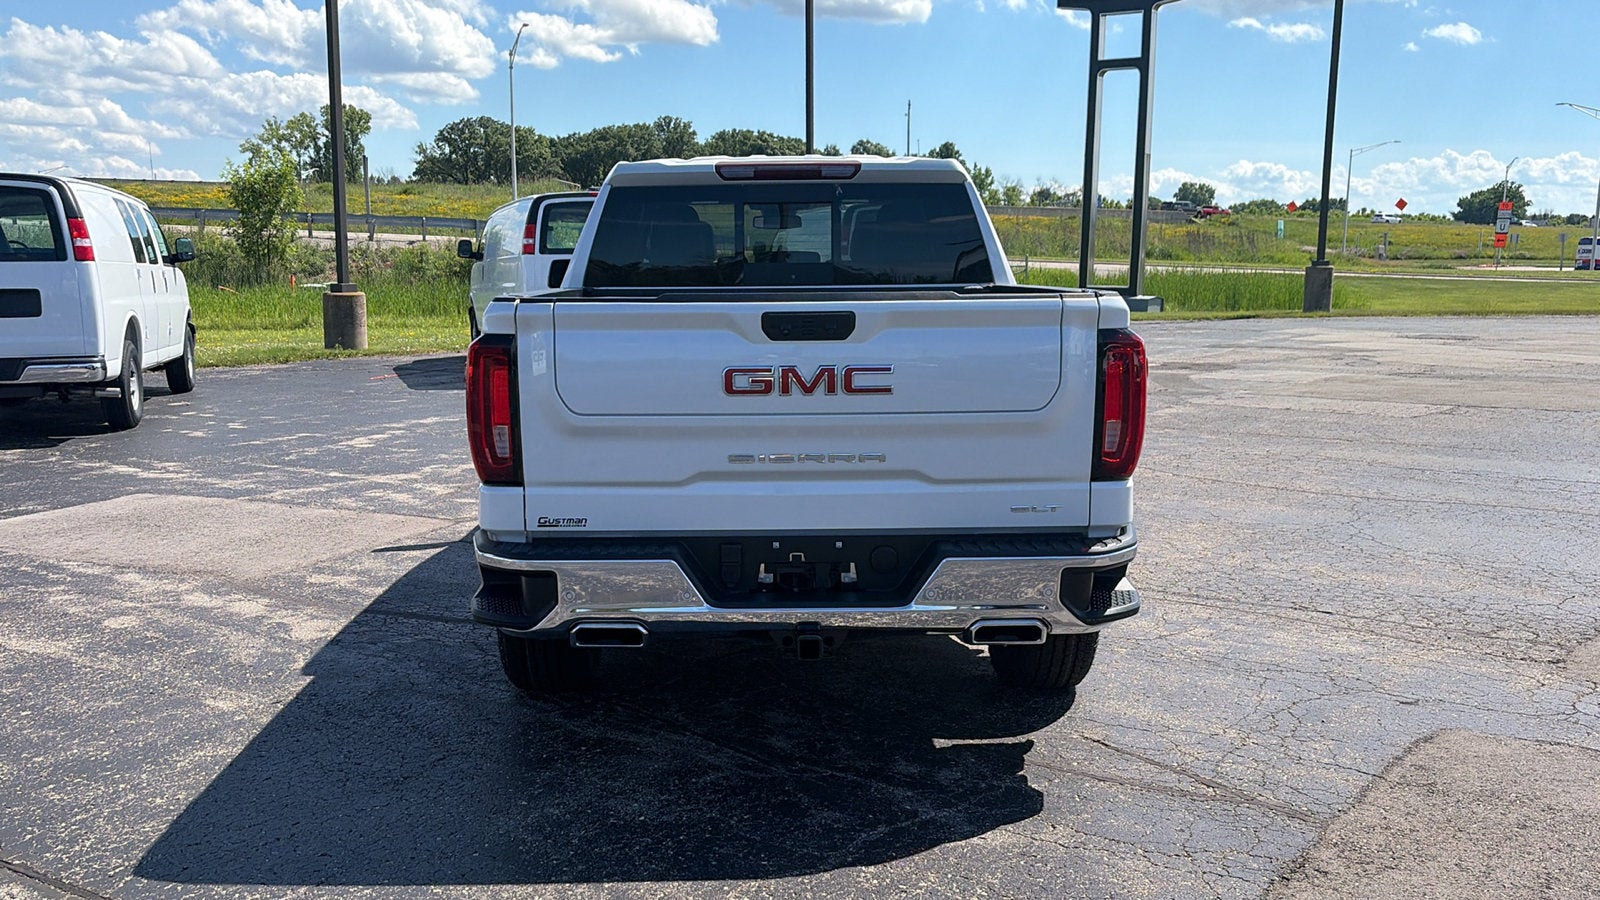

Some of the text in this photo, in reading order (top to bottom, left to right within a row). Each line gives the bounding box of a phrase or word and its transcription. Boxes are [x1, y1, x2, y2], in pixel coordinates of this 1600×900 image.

[1499, 223, 1506, 231] U
[722, 364, 895, 397] GMC
[728, 452, 887, 465] SIERRA
[1010, 503, 1064, 514] SLT
